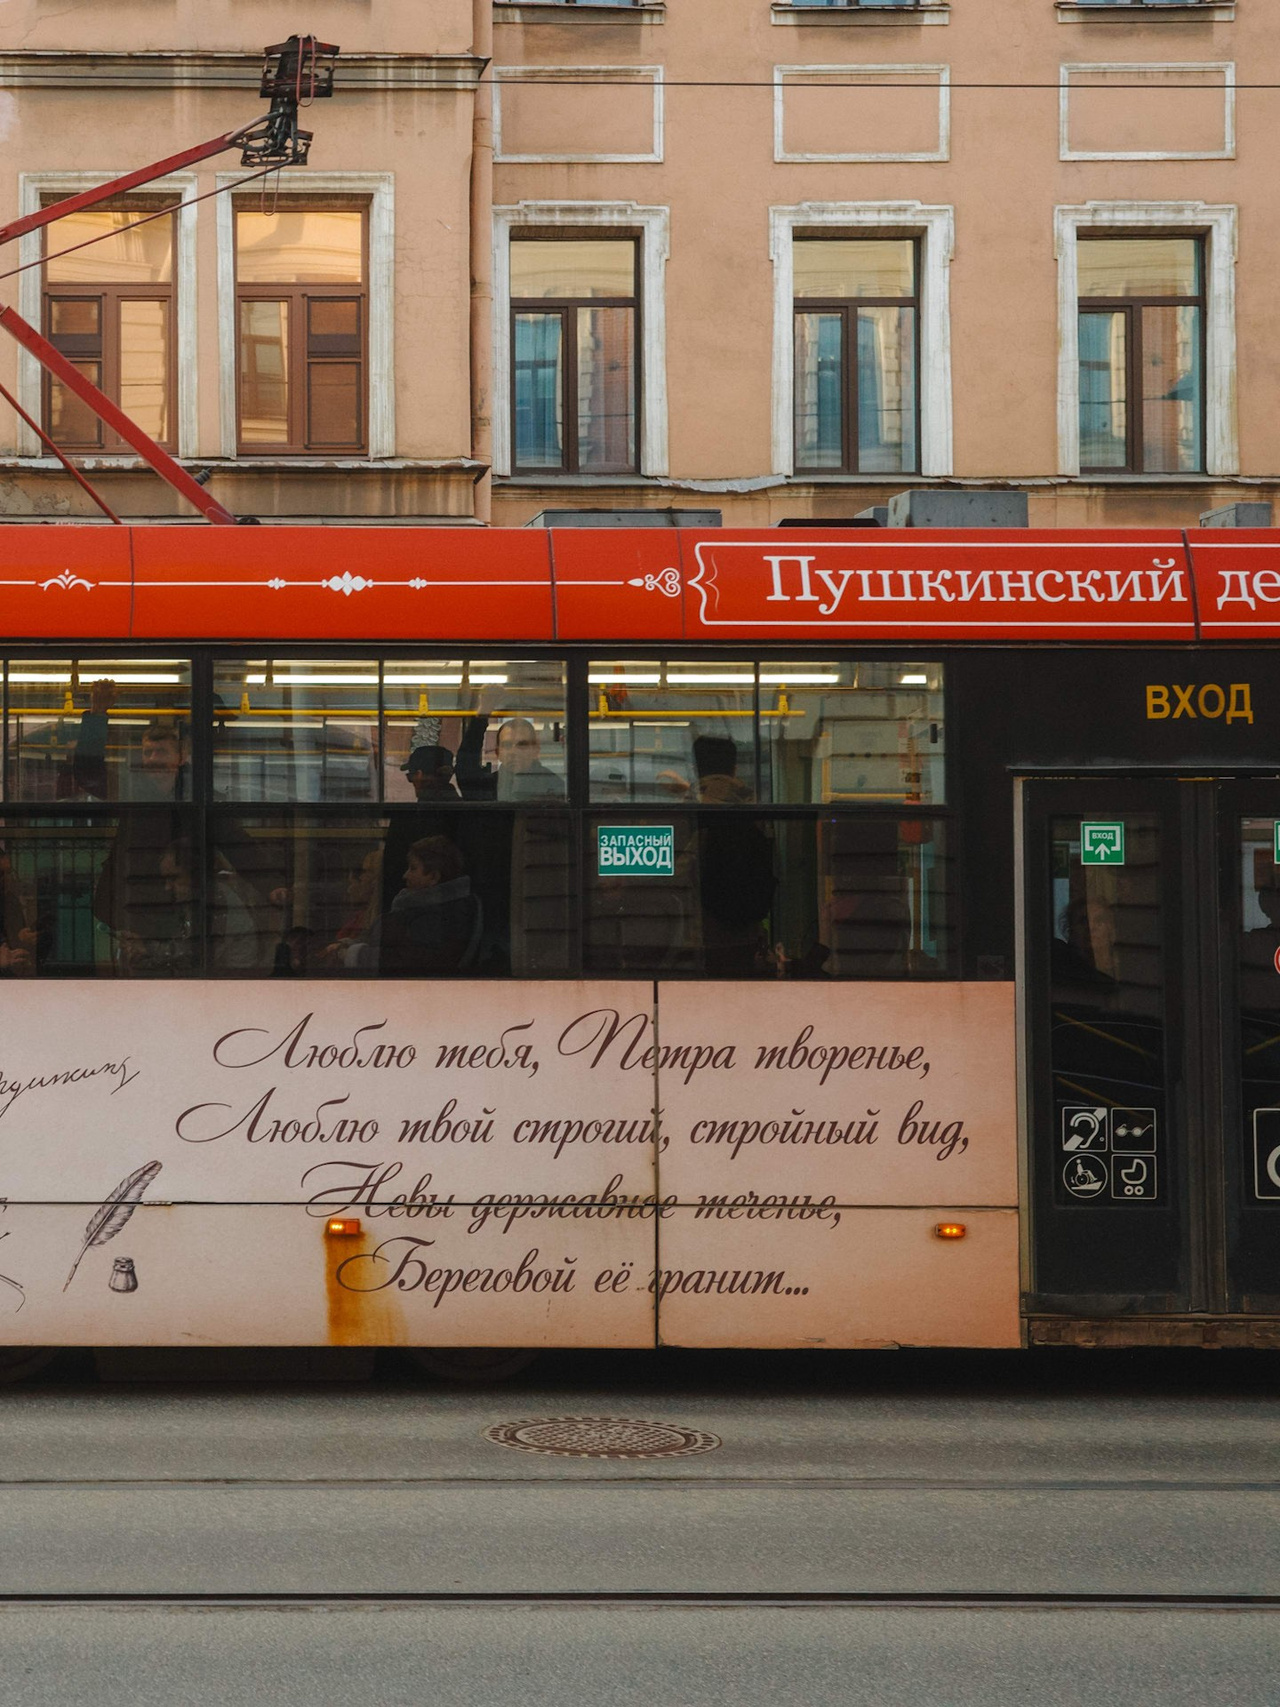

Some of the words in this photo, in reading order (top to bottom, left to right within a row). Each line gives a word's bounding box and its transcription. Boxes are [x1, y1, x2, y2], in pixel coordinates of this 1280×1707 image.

[763, 555, 1187, 615] Пушкинский
[1217, 570, 1280, 611] де
[1146, 683, 1254, 725] ВХОД
[600, 833, 671, 846] ЗАПАСНЫЙ
[600, 846, 671, 869] ВЫХОД
[1092, 832, 1114, 840] ВХОД
[213, 1012, 417, 1068] Люблю
[435, 1018, 540, 1078] тебя,
[557, 1008, 736, 1086] Петра
[754, 1025, 931, 1086] творенье,
[175, 1086, 380, 1143] Люблю
[398, 1098, 498, 1143] твой
[513, 1106, 671, 1159] строгий,
[690, 1108, 879, 1160] стройный
[897, 1100, 970, 1161] вид,
[301, 1161, 456, 1218] Невы
[467, 1173, 678, 1234] державное
[694, 1190, 841, 1230] теченье,
[336, 1236, 577, 1308] Береговой
[594, 1262, 634, 1293] её
